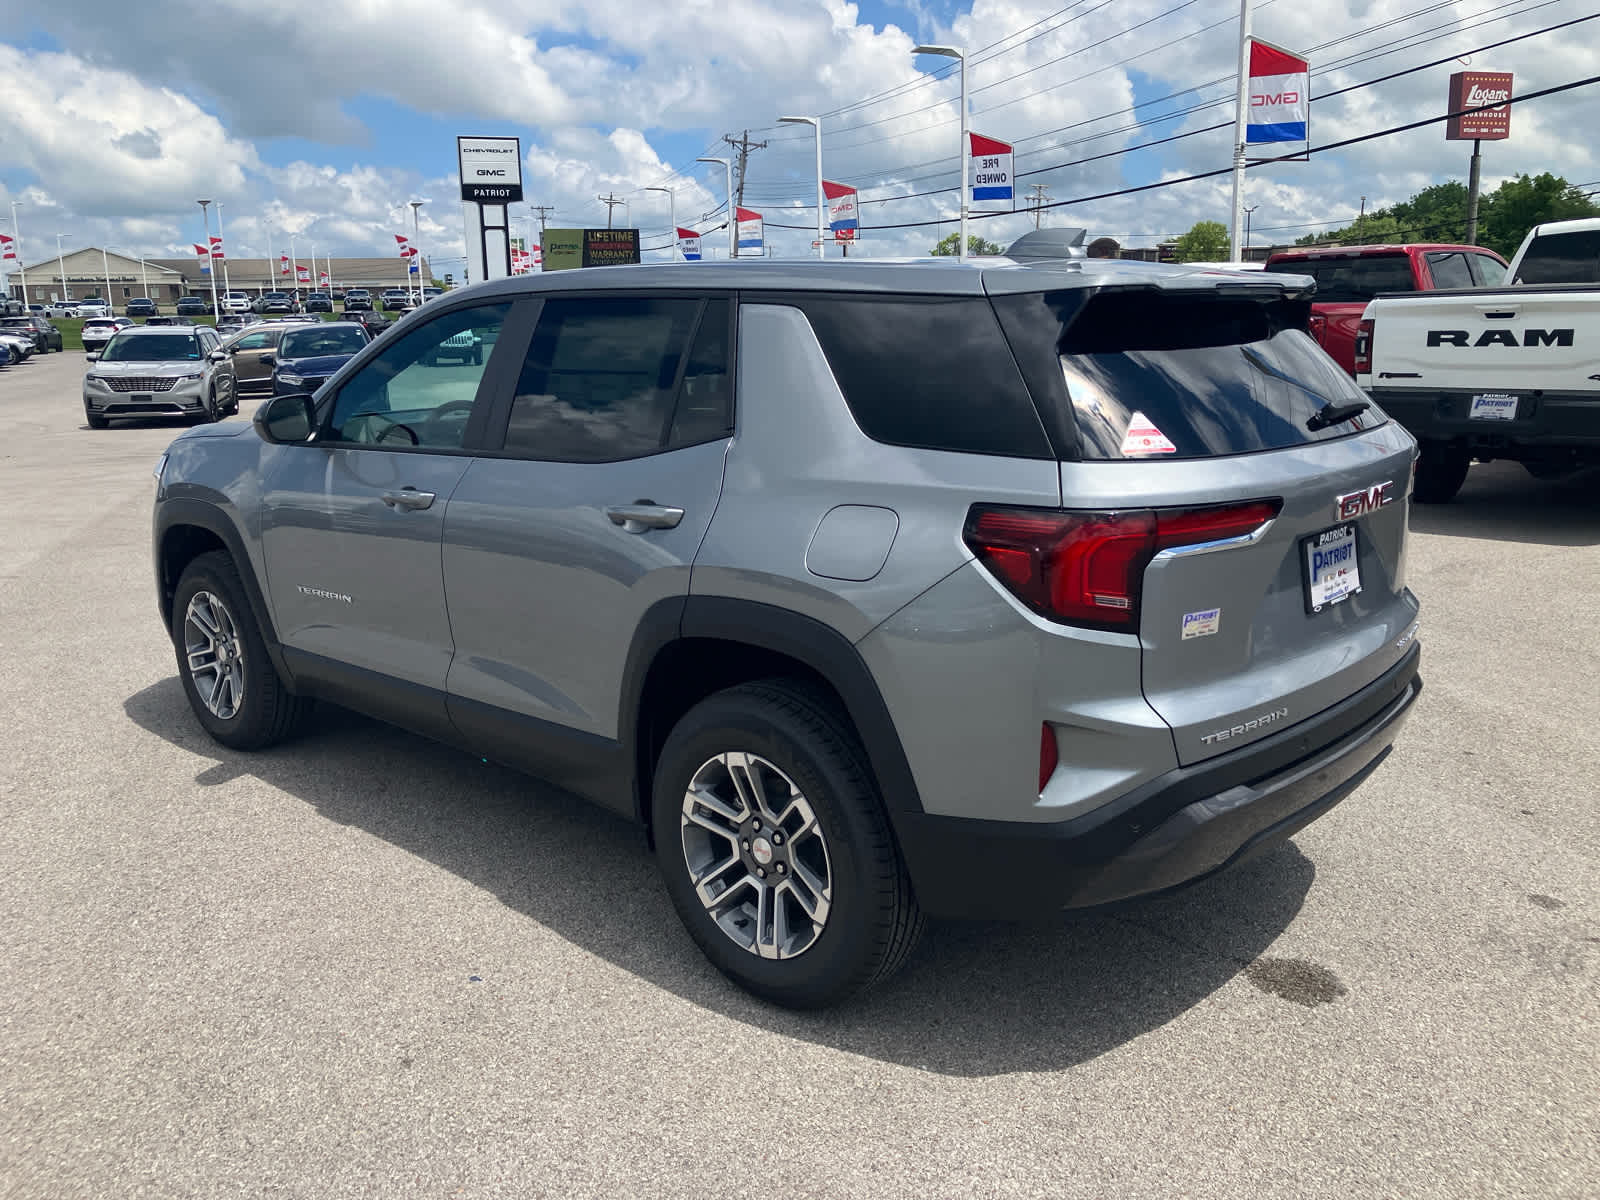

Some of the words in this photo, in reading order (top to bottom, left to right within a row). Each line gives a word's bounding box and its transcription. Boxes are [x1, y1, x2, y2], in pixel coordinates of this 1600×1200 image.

[1465, 84, 1508, 110] Logan's
[473, 189, 511, 197] PATRIOT
[588, 231, 634, 241] LIFETIME
[591, 250, 634, 258] WARRANTY
[1427, 329, 1574, 347] RAM
[1475, 399, 1514, 409] PATRIOT
[1337, 481, 1393, 520] GMC
[1319, 526, 1348, 546] PATRIOT
[1313, 543, 1353, 583] PATRIOT
[296, 585, 352, 603] TERRAIN
[1200, 707, 1288, 745] TERRAIN
